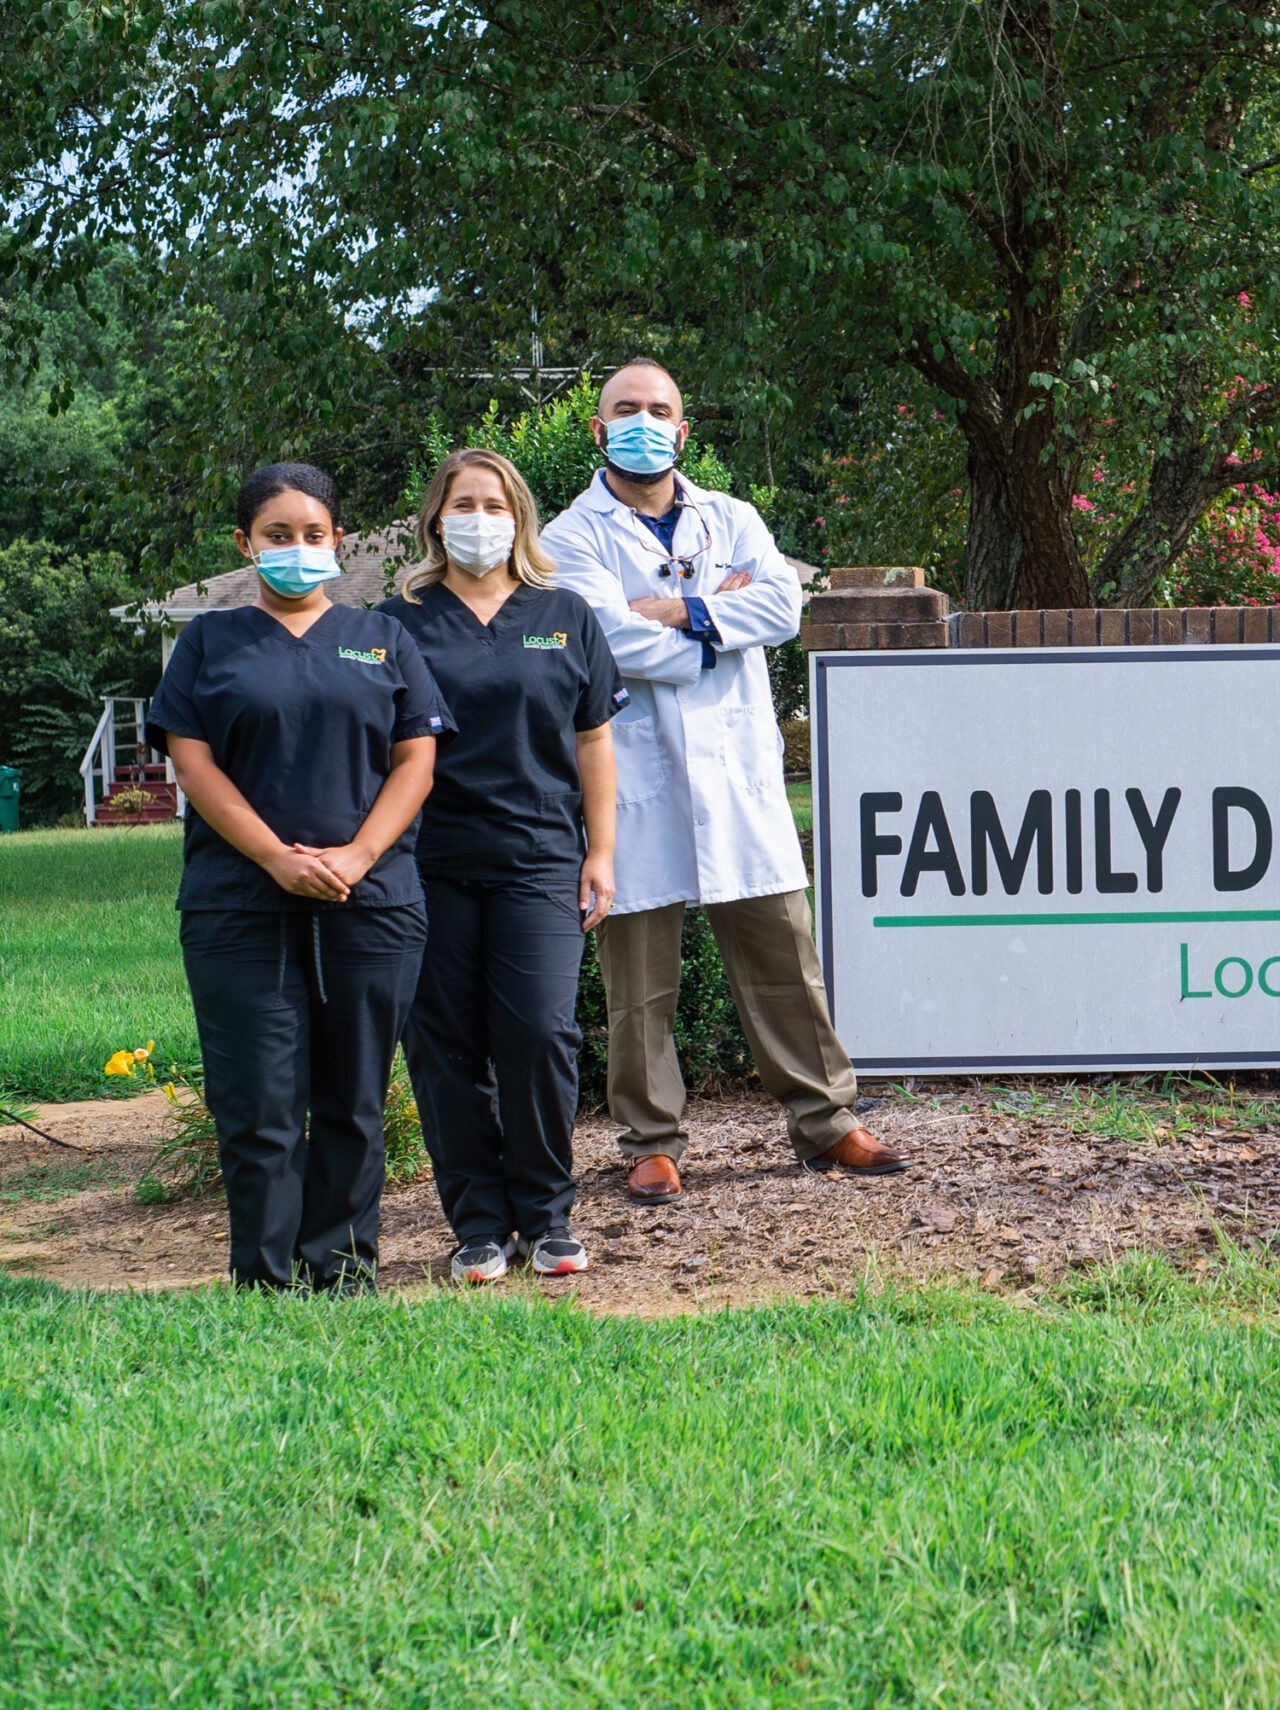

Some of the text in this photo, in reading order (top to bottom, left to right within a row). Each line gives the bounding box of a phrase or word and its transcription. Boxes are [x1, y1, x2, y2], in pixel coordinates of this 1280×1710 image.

[522, 634, 559, 646] Locust
[338, 646, 377, 661] Locust
[860, 787, 1182, 898] FAMILY
